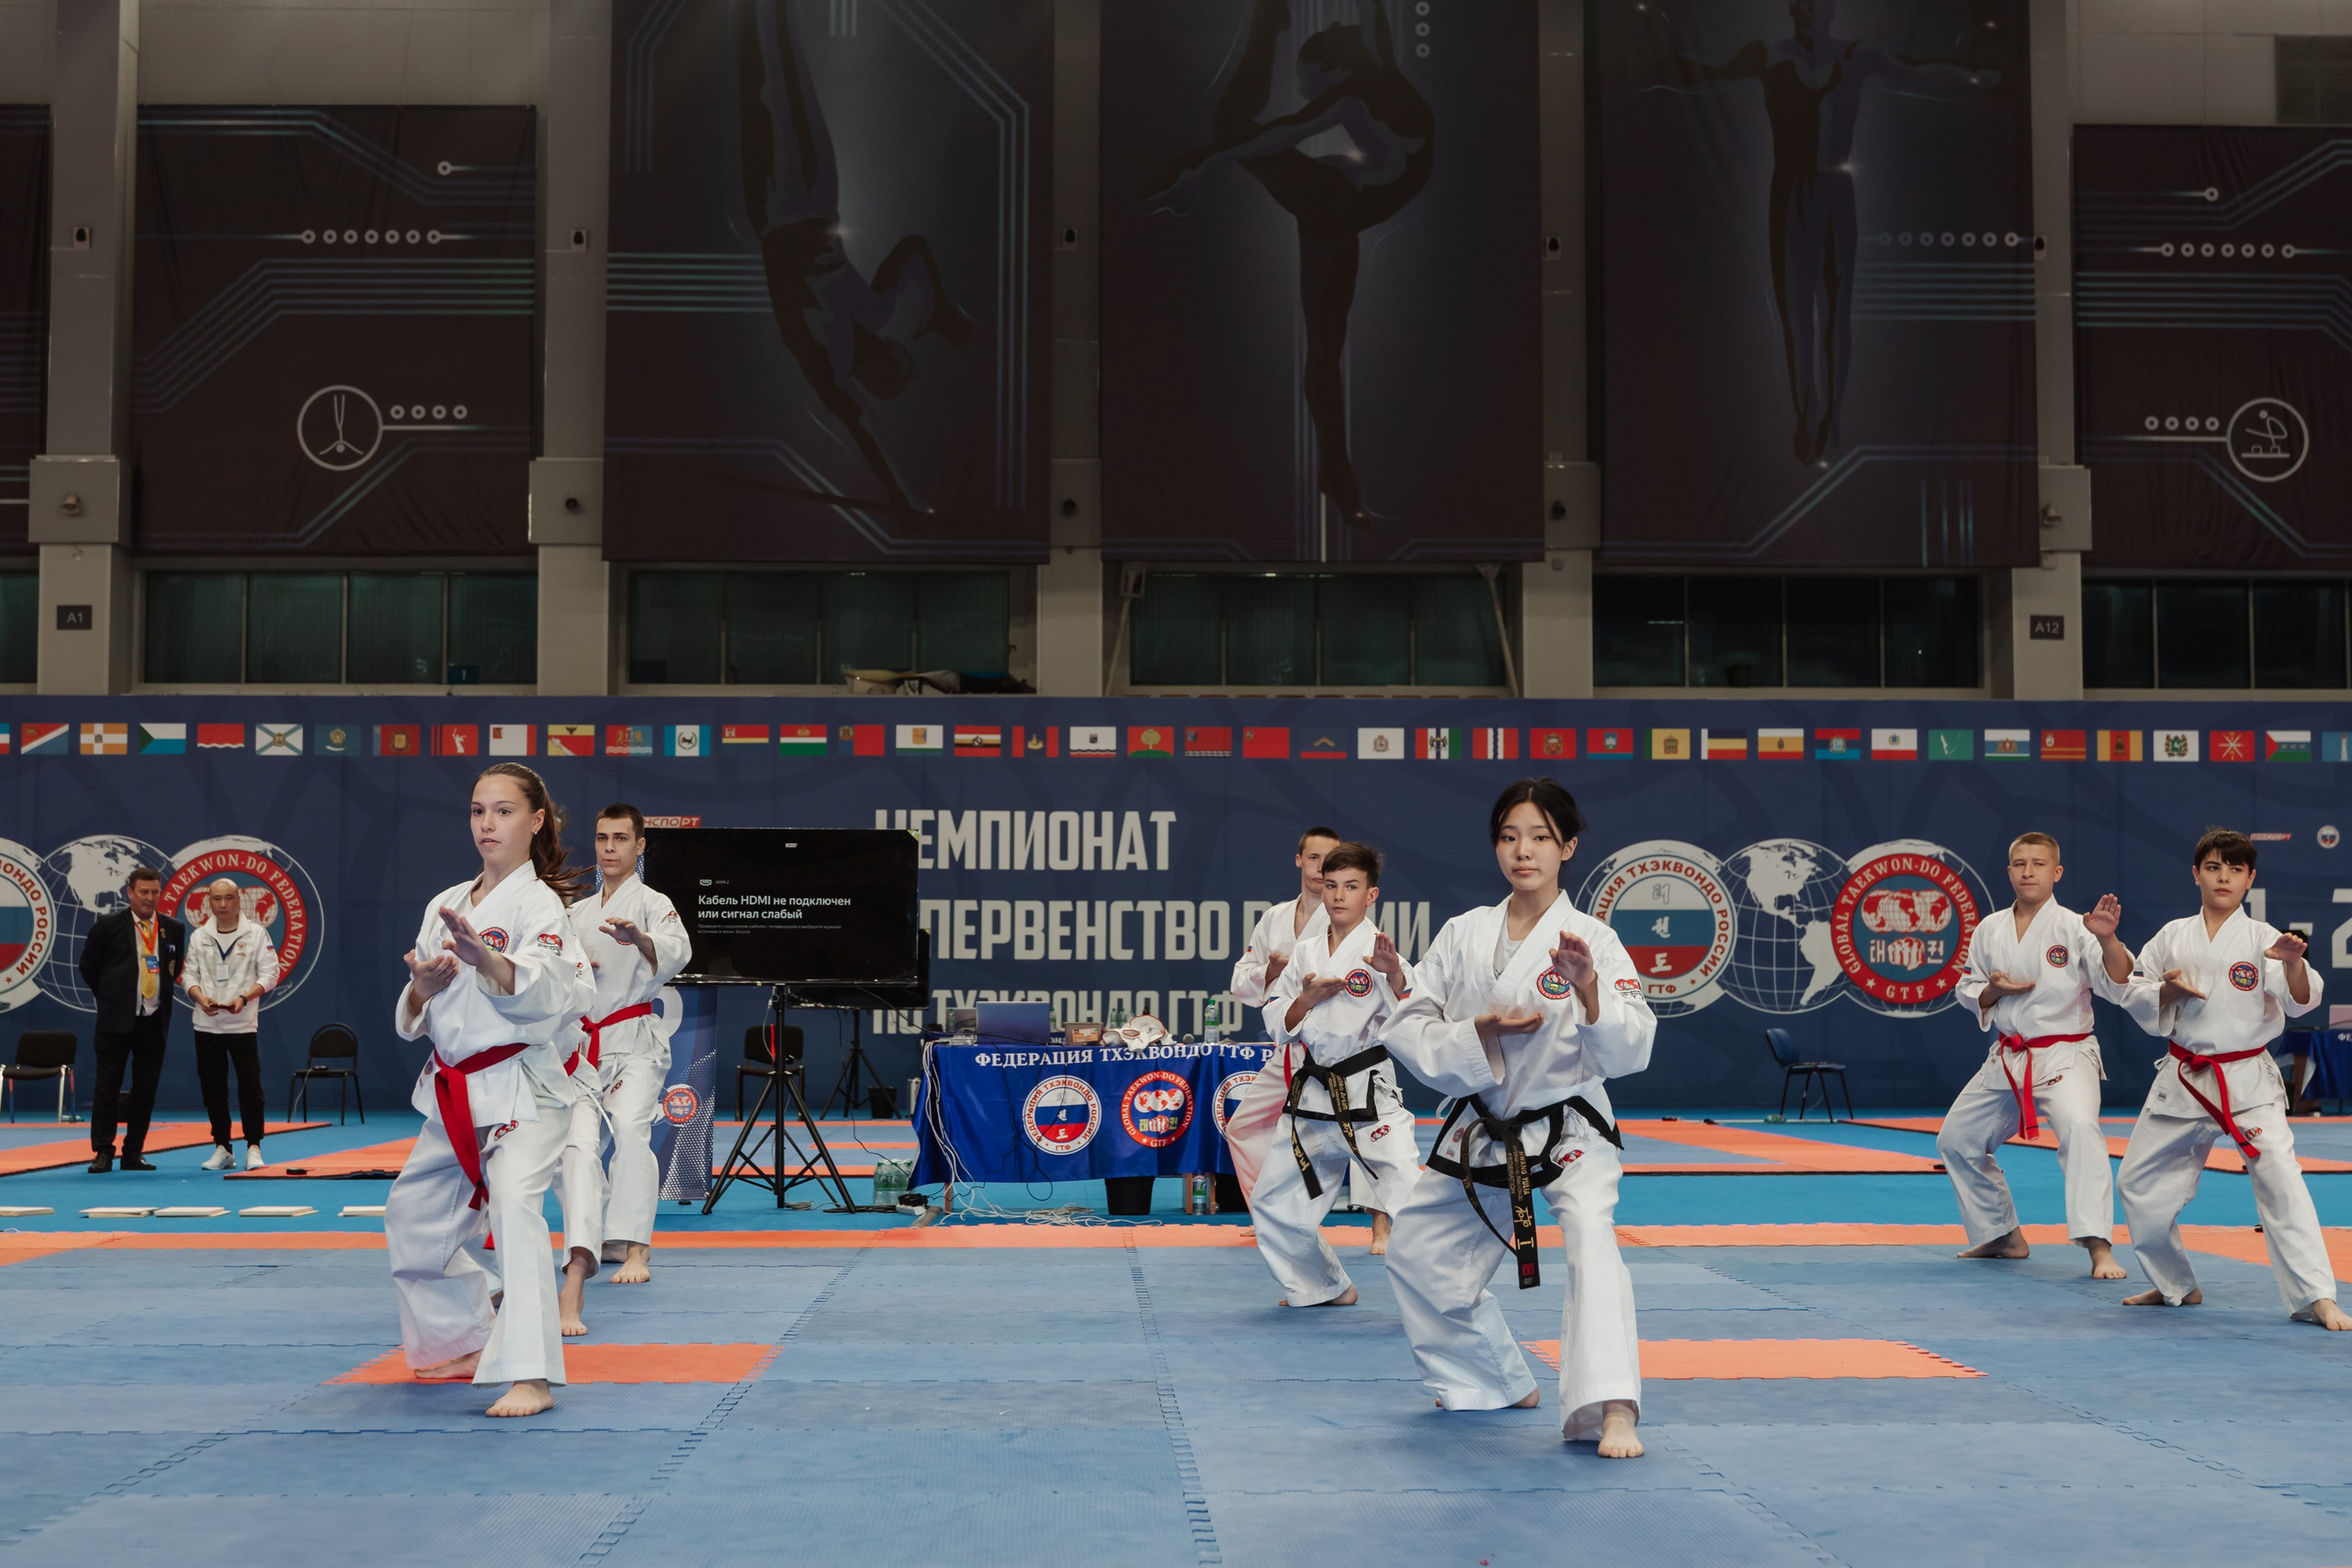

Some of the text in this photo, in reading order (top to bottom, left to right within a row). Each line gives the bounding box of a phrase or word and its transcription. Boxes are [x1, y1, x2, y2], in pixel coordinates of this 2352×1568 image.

[67, 612, 83, 624] A1
[2035, 622, 2060, 634] A12
[1841, 857, 1940, 906] TAEKWON-DO
[164, 853, 304, 973] TAEKWON-DO FEDERATION
[697, 908, 803, 919] или сигнал слабый
[698, 895, 851, 908] Кабель HDMI не подключен
[920, 899, 1230, 960] ПЕРВЕНСТВО
[1626, 860, 1723, 904] ТХЭКВОНДО
[1700, 908, 1730, 977] РОССИИ
[16, 906, 48, 976] РОССИИ
[1836, 911, 1861, 974] GLOBAL
[1648, 984, 1677, 994] ГТФ
[1886, 985, 1925, 999] GTF
[975, 1049, 1093, 1069] ФЕДЕРАЦИЯ
[1099, 1044, 1213, 1062] ТХЭКВОНДО
[1218, 1044, 1255, 1060] ГТФ
[1043, 1079, 1093, 1101] ТХЭКВОНДО
[1081, 1103, 1097, 1141] РОССИИ
[1122, 1072, 1193, 1135] GLOBAL TAEKWON-DO FEDERATION
[1150, 1139, 1168, 1147] GTF
[1521, 1177, 1531, 1195] YULIA
